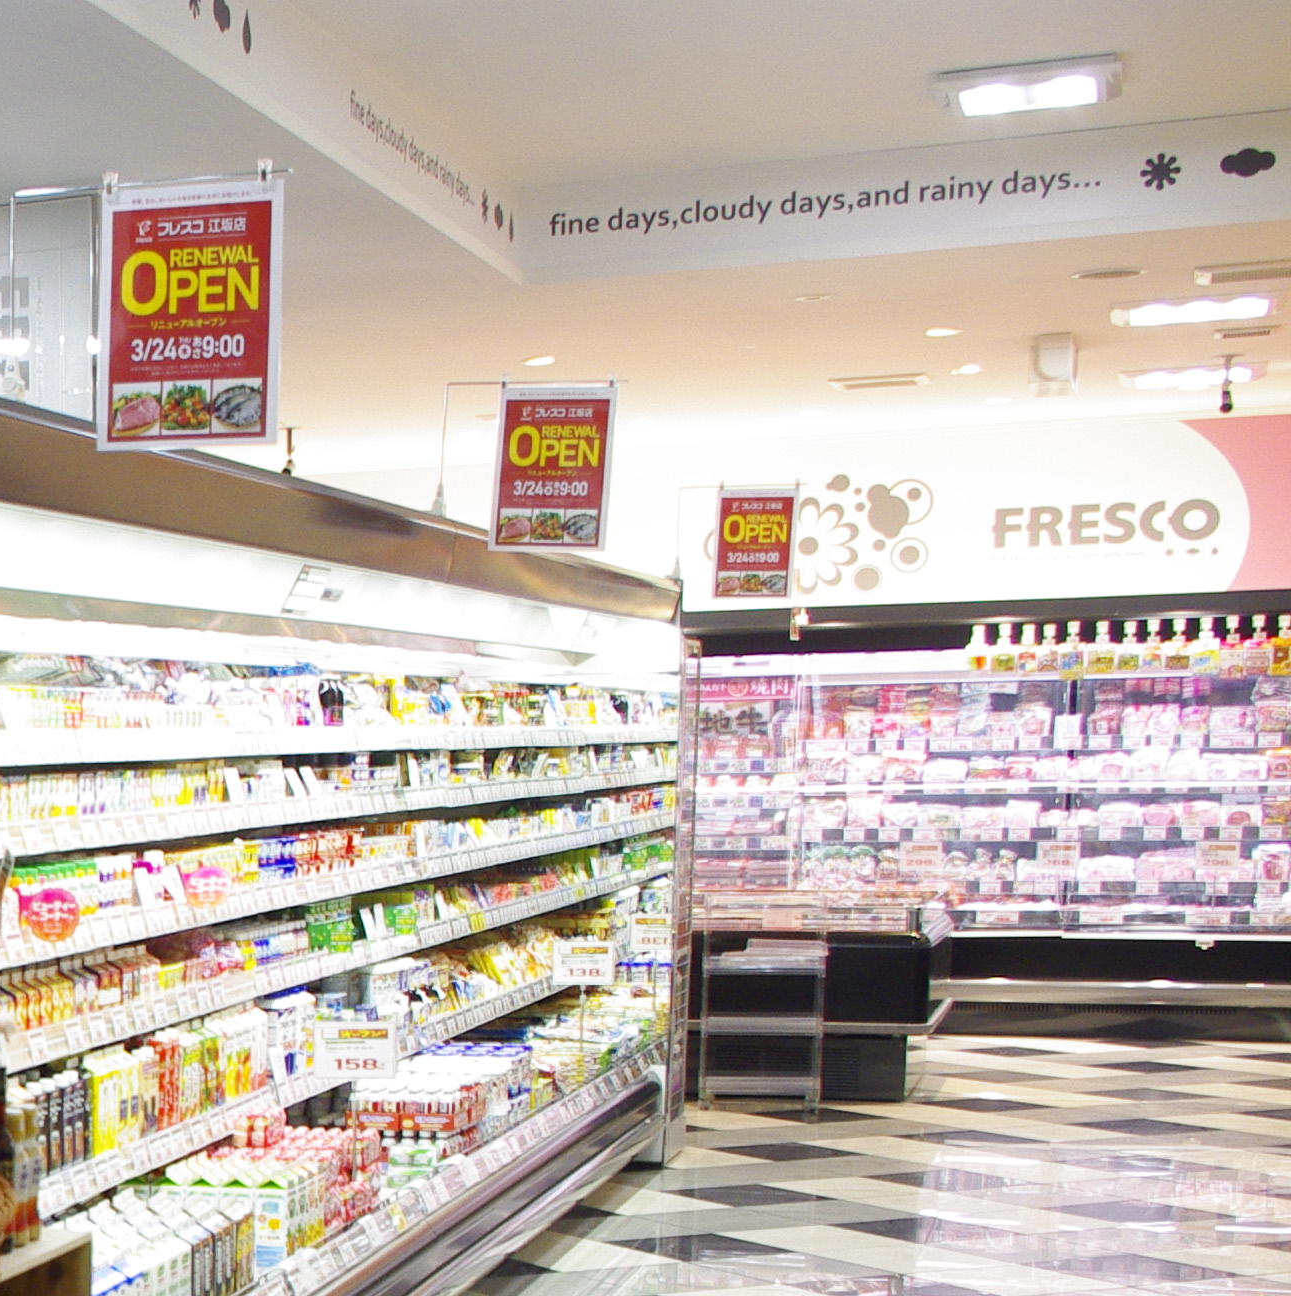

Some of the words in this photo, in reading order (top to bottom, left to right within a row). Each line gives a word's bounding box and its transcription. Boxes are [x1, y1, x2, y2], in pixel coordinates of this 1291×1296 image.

[549, 212, 600, 237] fine
[606, 195, 773, 236] days,cloudy
[780, 181, 910, 218] days,and
[919, 177, 993, 204] rainy
[157, 219, 205, 238] フレスコ
[170, 244, 260, 269] RENEWAL
[121, 249, 261, 316] OPEN
[130, 336, 179, 363] 3/24
[509, 425, 600, 467] OPEN
[542, 424, 600, 438] RENEWAL
[723, 514, 788, 544] OPEN
[991, 498, 1221, 550] FRESCO
